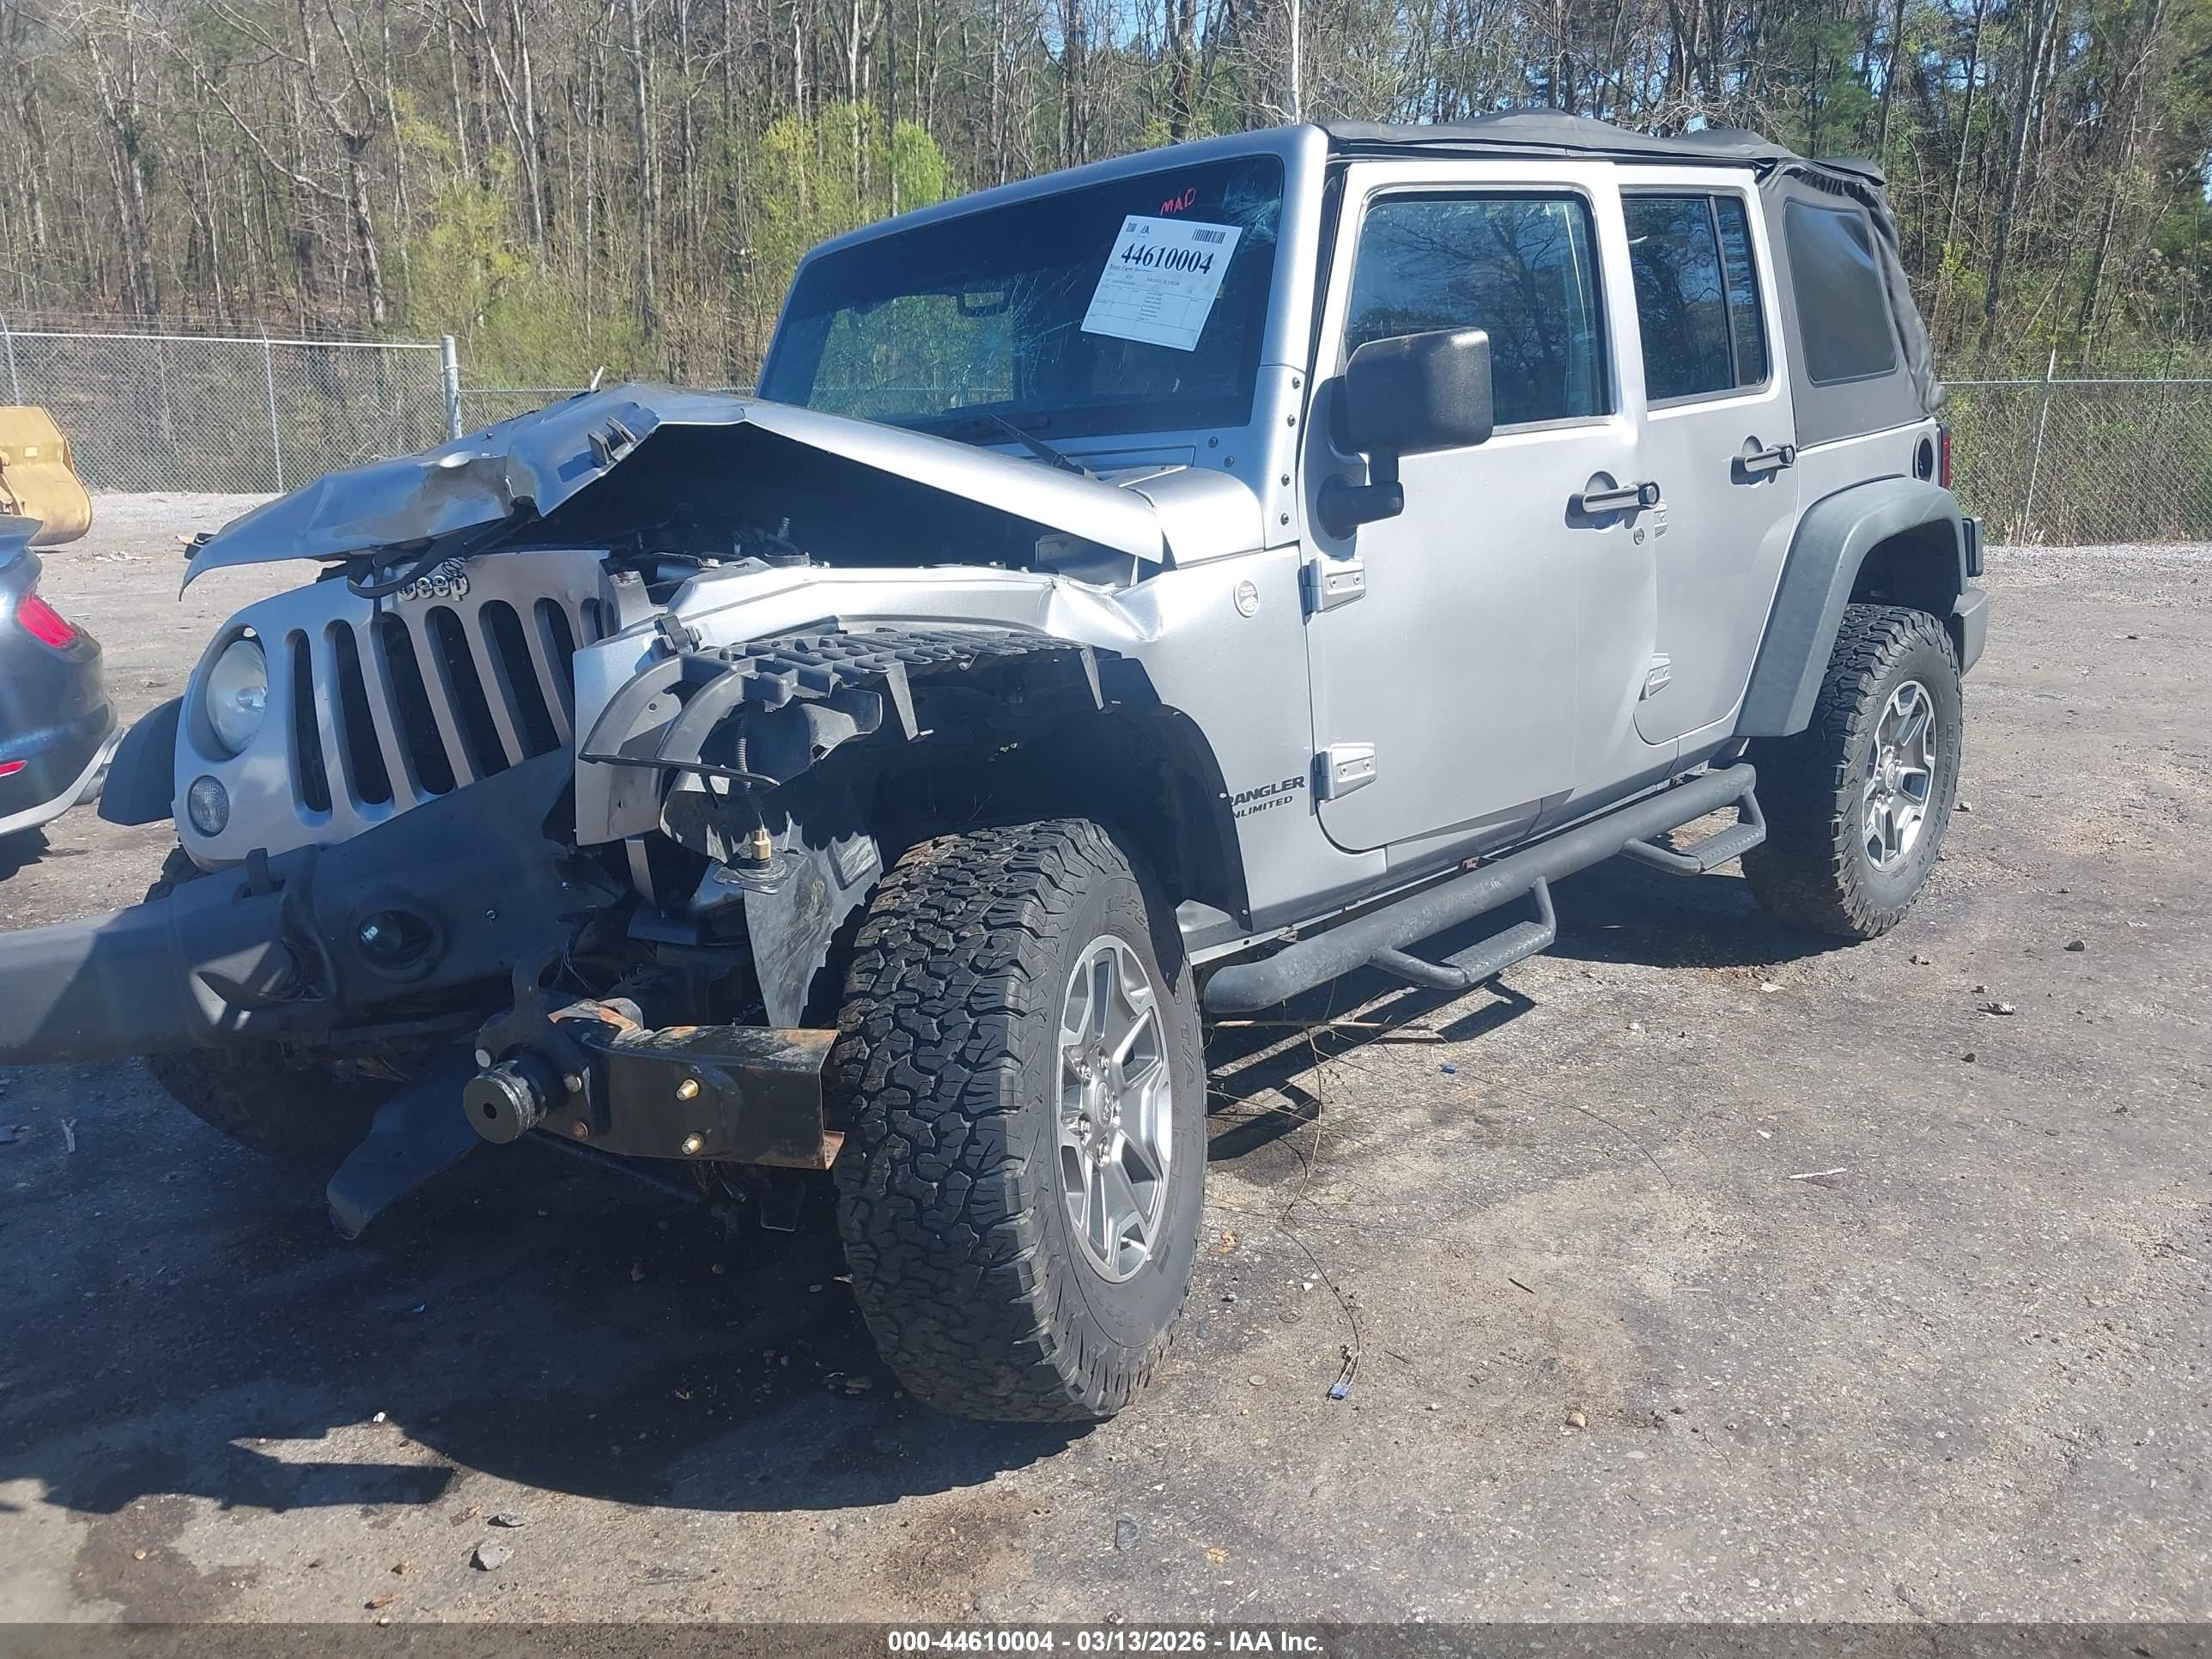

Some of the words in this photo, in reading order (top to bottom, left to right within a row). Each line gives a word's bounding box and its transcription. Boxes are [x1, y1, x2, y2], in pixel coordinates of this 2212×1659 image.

[1121, 242, 1215, 275] 44610004
[1229, 775, 1306, 807] RANGLER
[1233, 795, 1293, 819] NLIMITED
